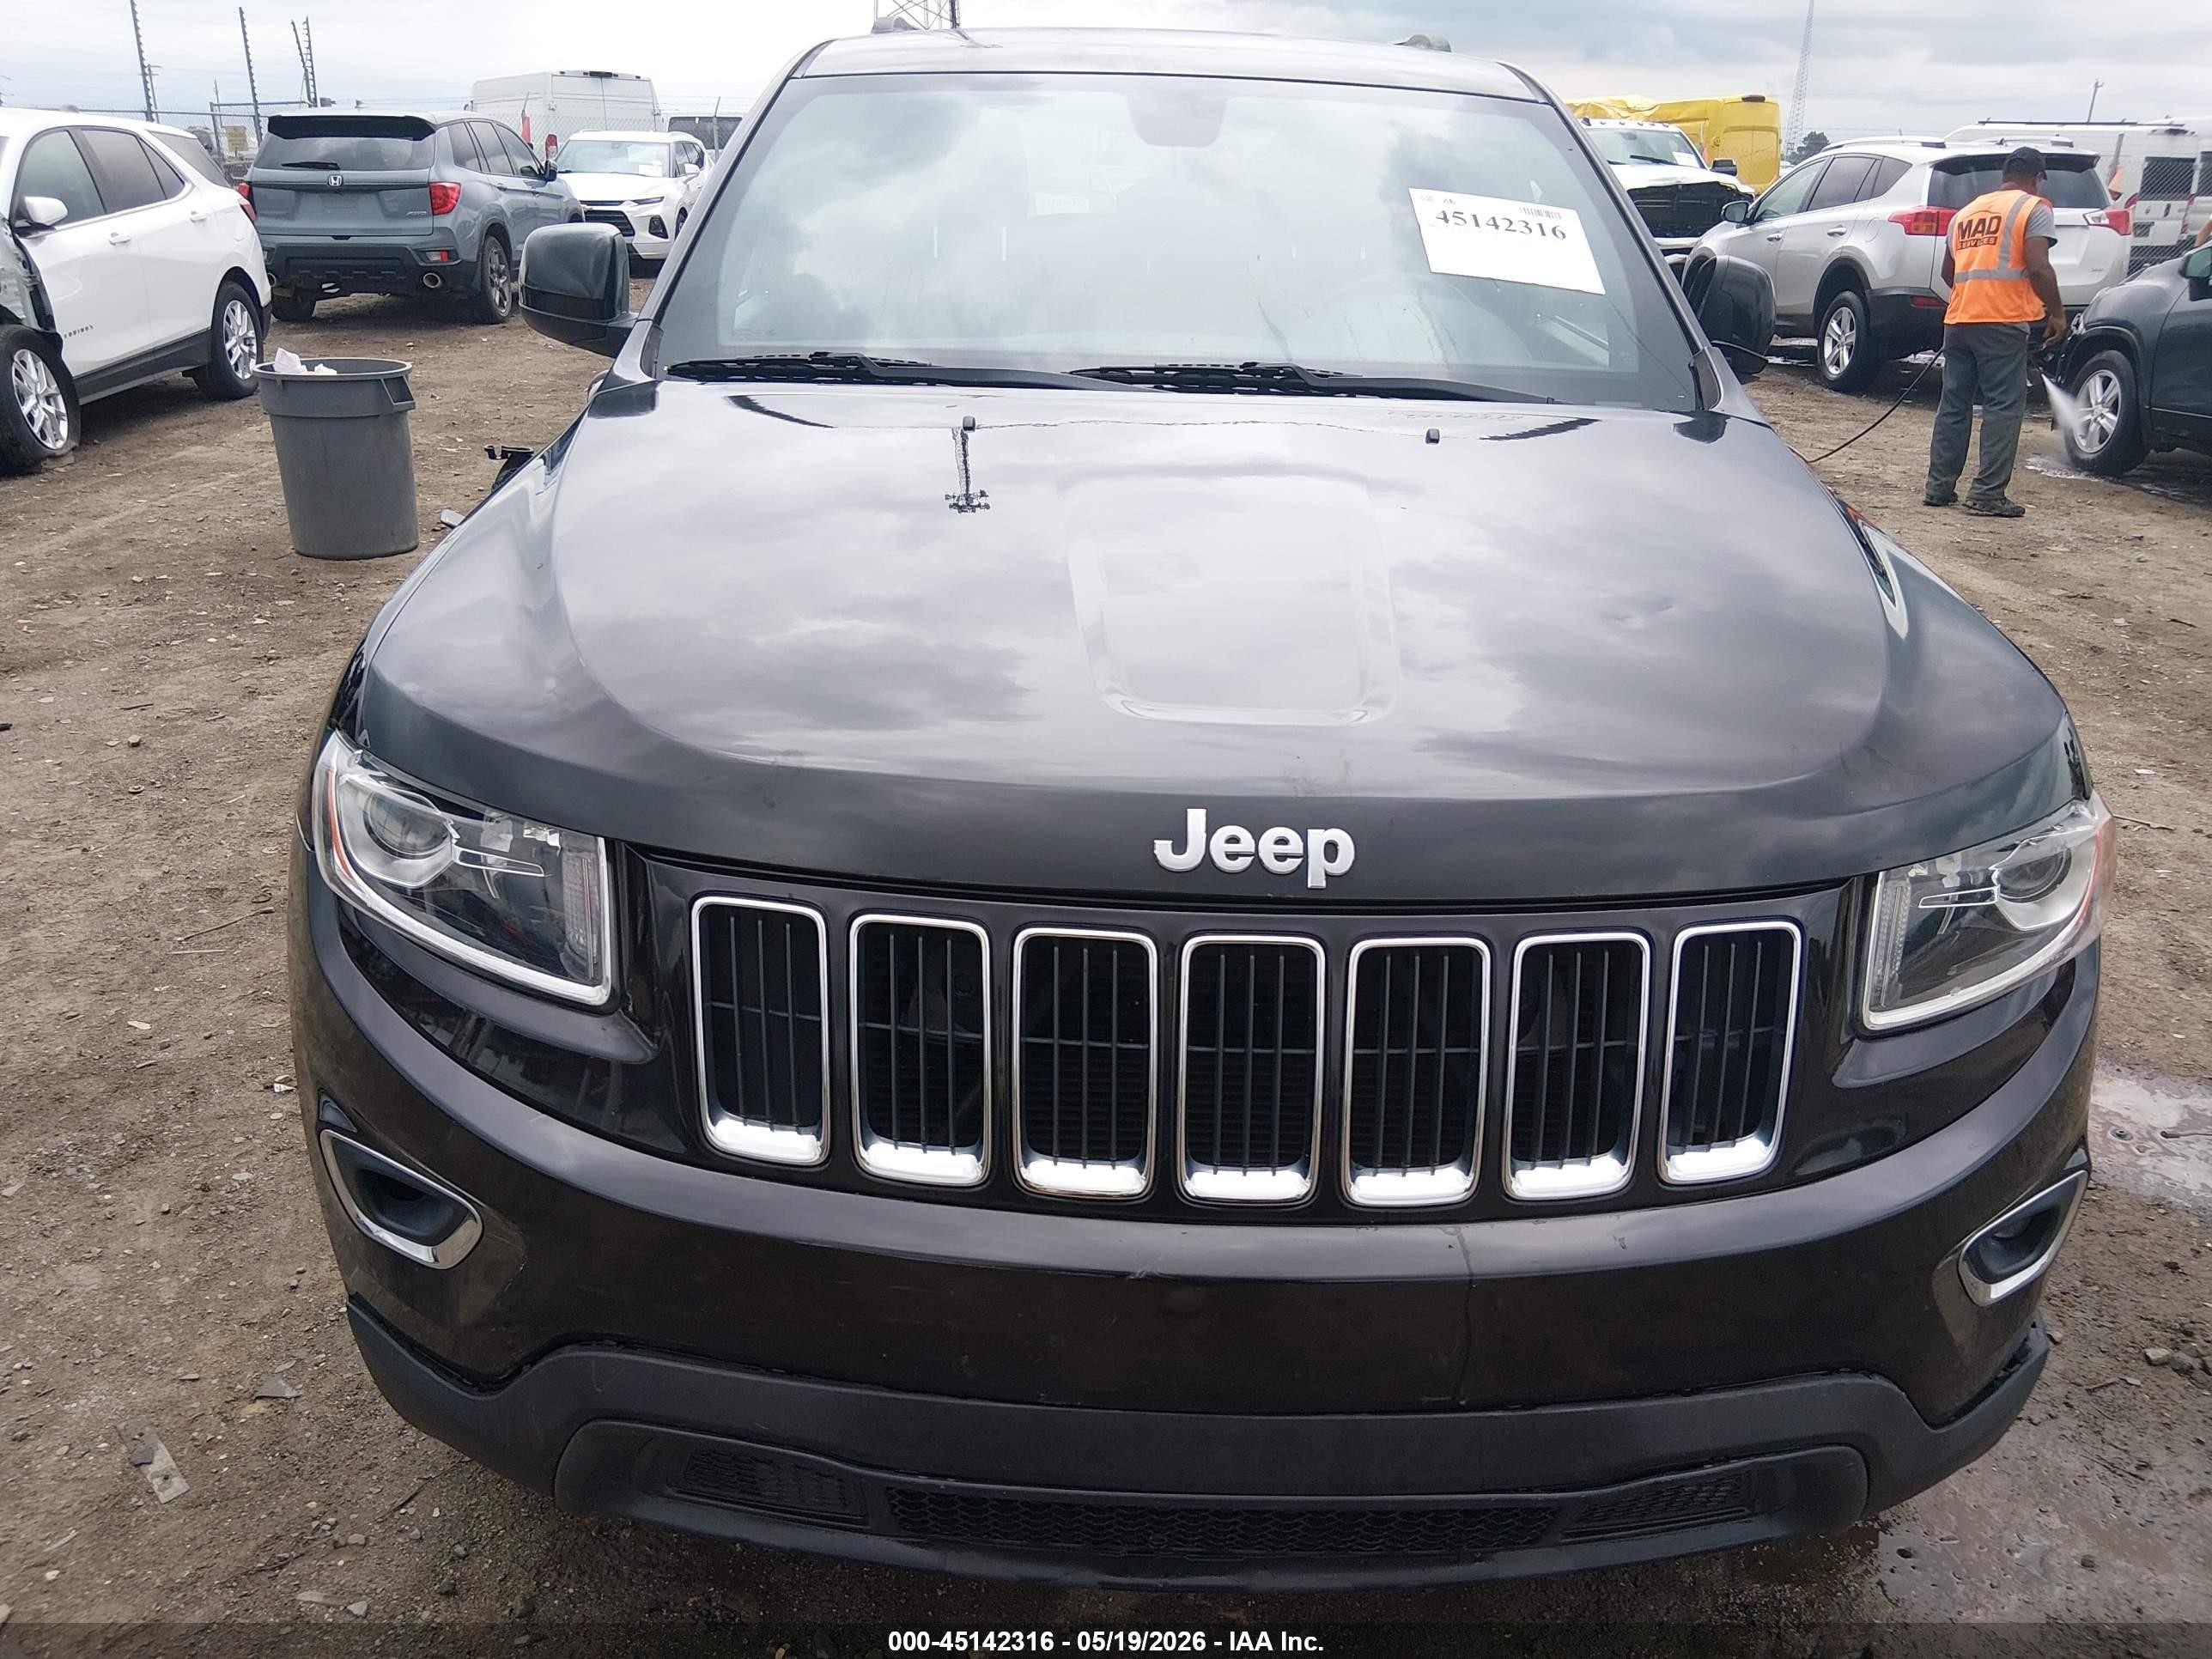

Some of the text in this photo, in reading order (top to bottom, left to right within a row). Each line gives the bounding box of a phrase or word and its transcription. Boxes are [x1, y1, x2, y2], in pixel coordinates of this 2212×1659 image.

[1435, 210, 1567, 240] 45142316
[1957, 216, 2002, 240] MAD
[1153, 808, 1355, 889] Jeep
